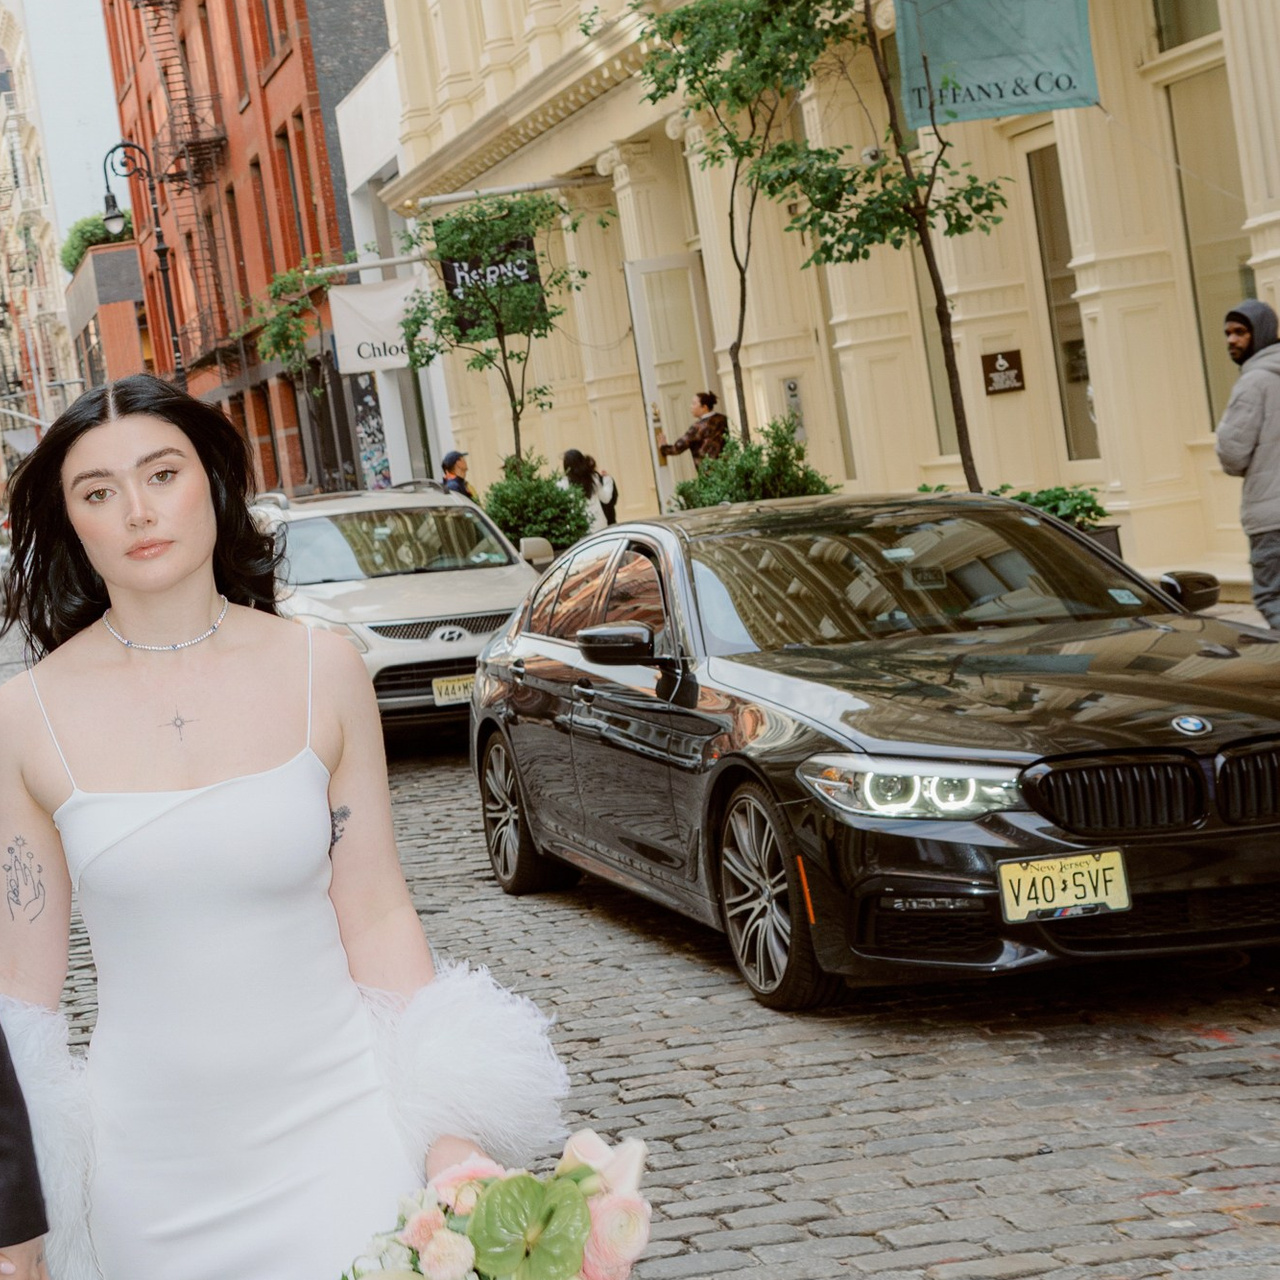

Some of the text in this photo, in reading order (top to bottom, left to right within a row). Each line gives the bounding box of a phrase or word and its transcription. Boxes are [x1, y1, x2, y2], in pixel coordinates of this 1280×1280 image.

[912, 80, 1007, 109] TFFANY
[1012, 77, 1029, 97] &
[1029, 859, 1091, 873] New Jersey
